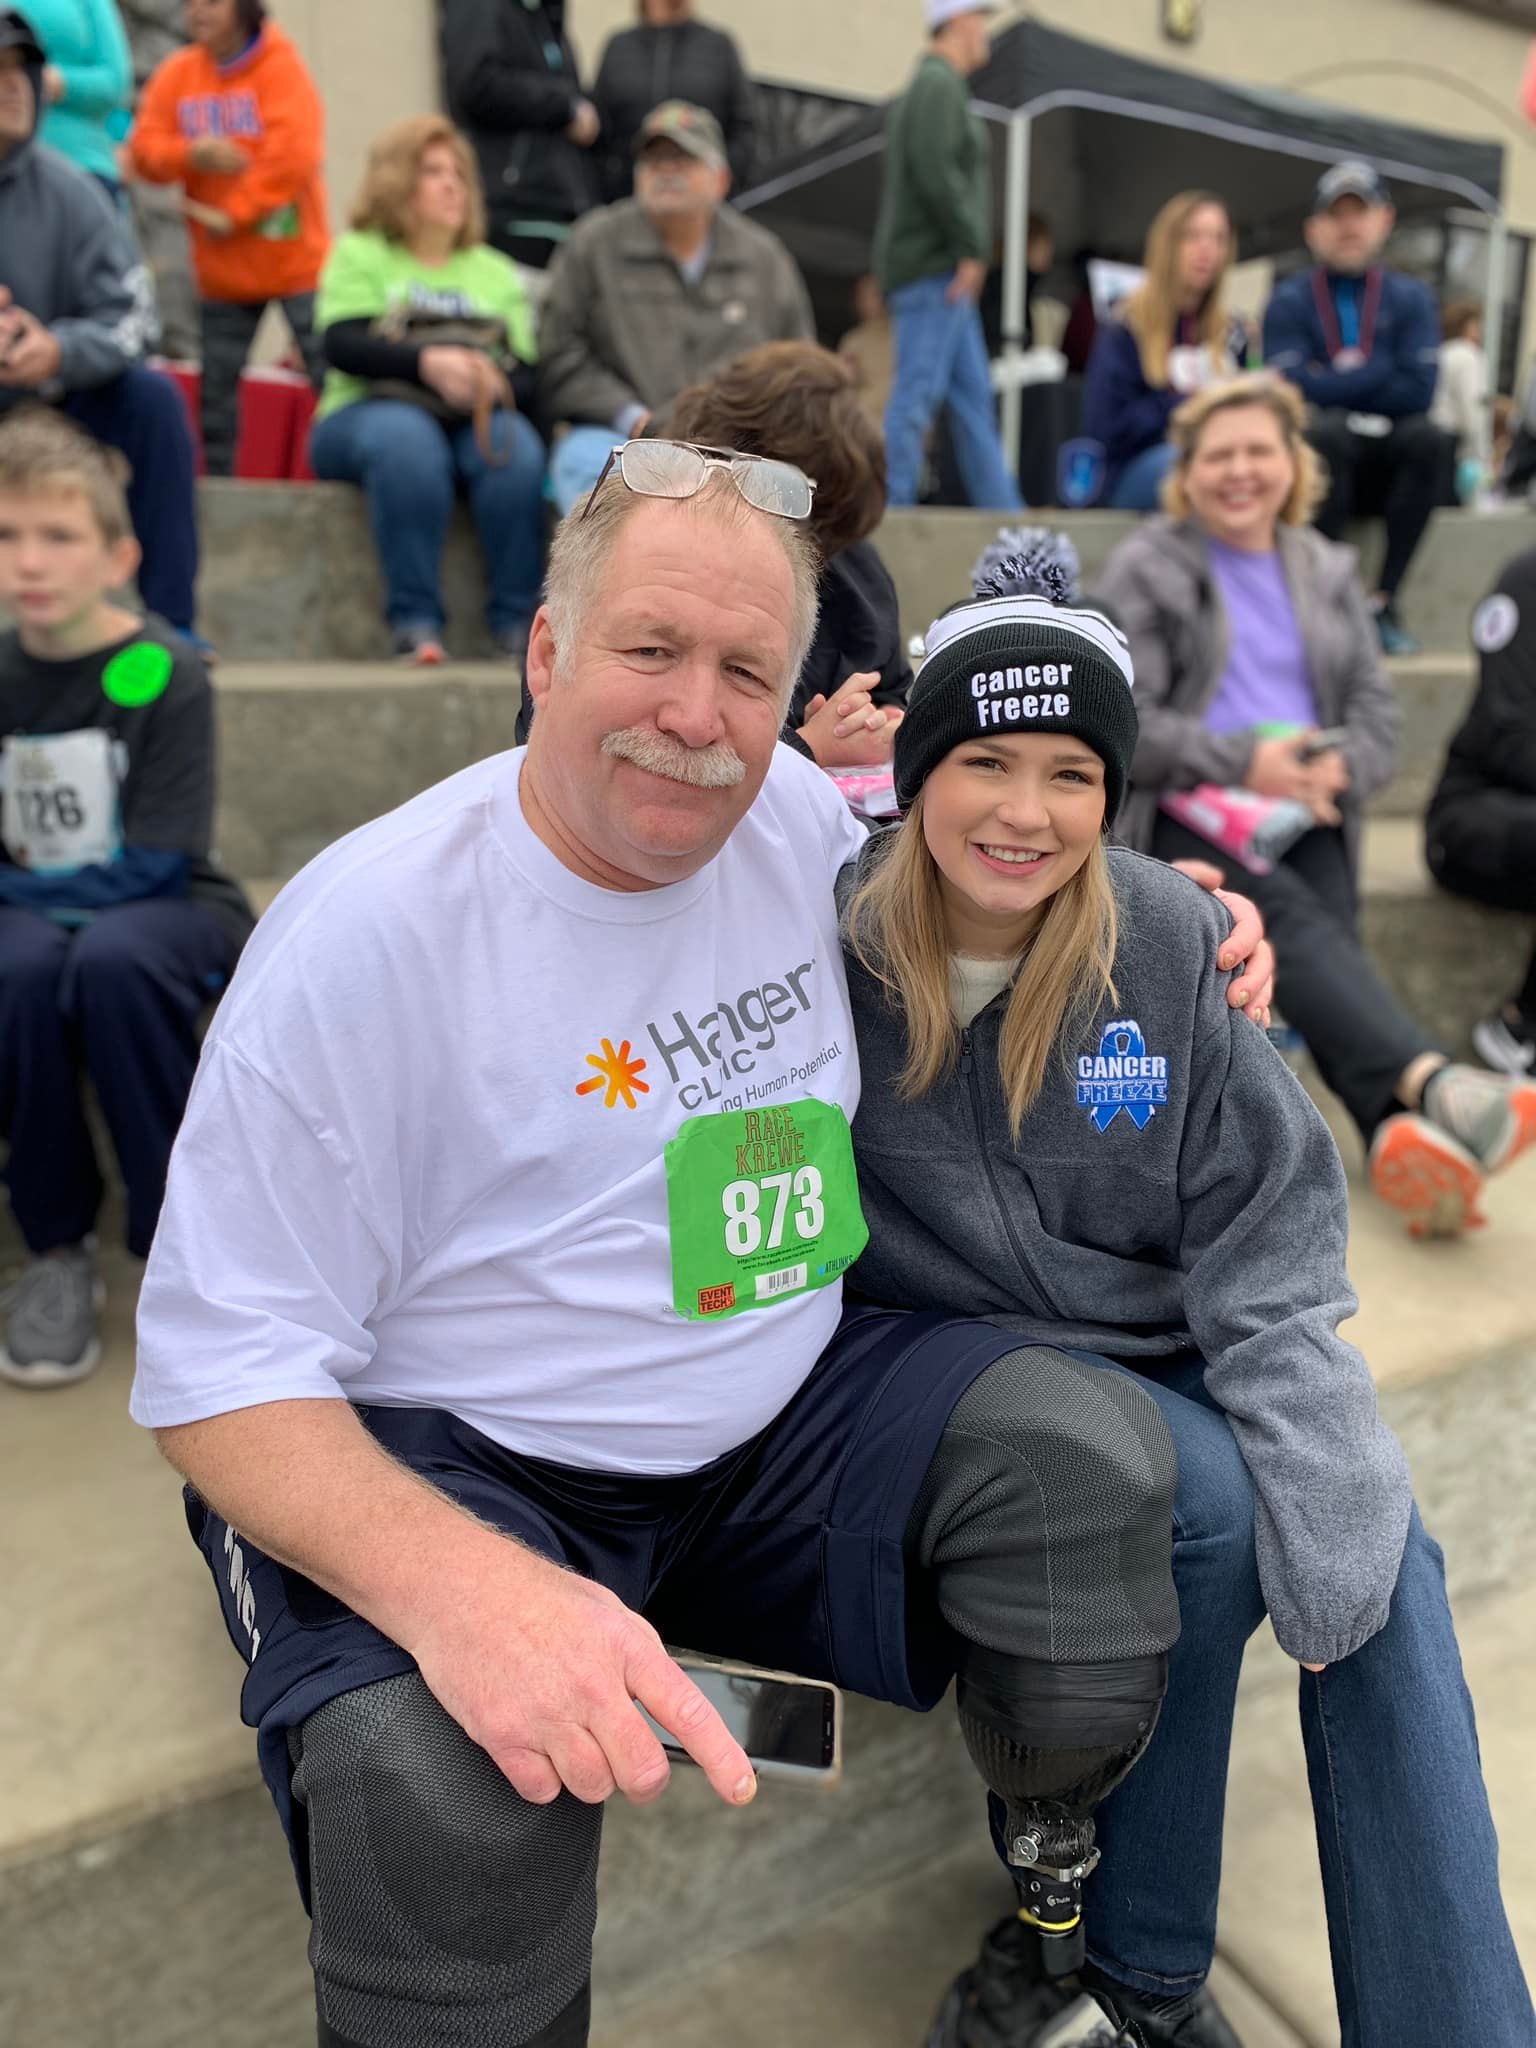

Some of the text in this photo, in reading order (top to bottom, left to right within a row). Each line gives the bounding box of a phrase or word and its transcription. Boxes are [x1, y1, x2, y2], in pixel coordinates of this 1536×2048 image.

[971, 663, 1072, 698] Cancer
[977, 693, 1070, 727] Freeze
[678, 1048, 756, 1110] CLIC
[745, 1074, 789, 1102] Human
[790, 1041, 842, 1086] Potential
[1078, 1056, 1166, 1079] CANCER
[1077, 1079, 1168, 1103] FREEZE
[745, 1105, 796, 1143] RACE
[736, 1132, 806, 1176] KREWE
[722, 1164, 825, 1256] 873
[700, 1286, 733, 1301] EVENT
